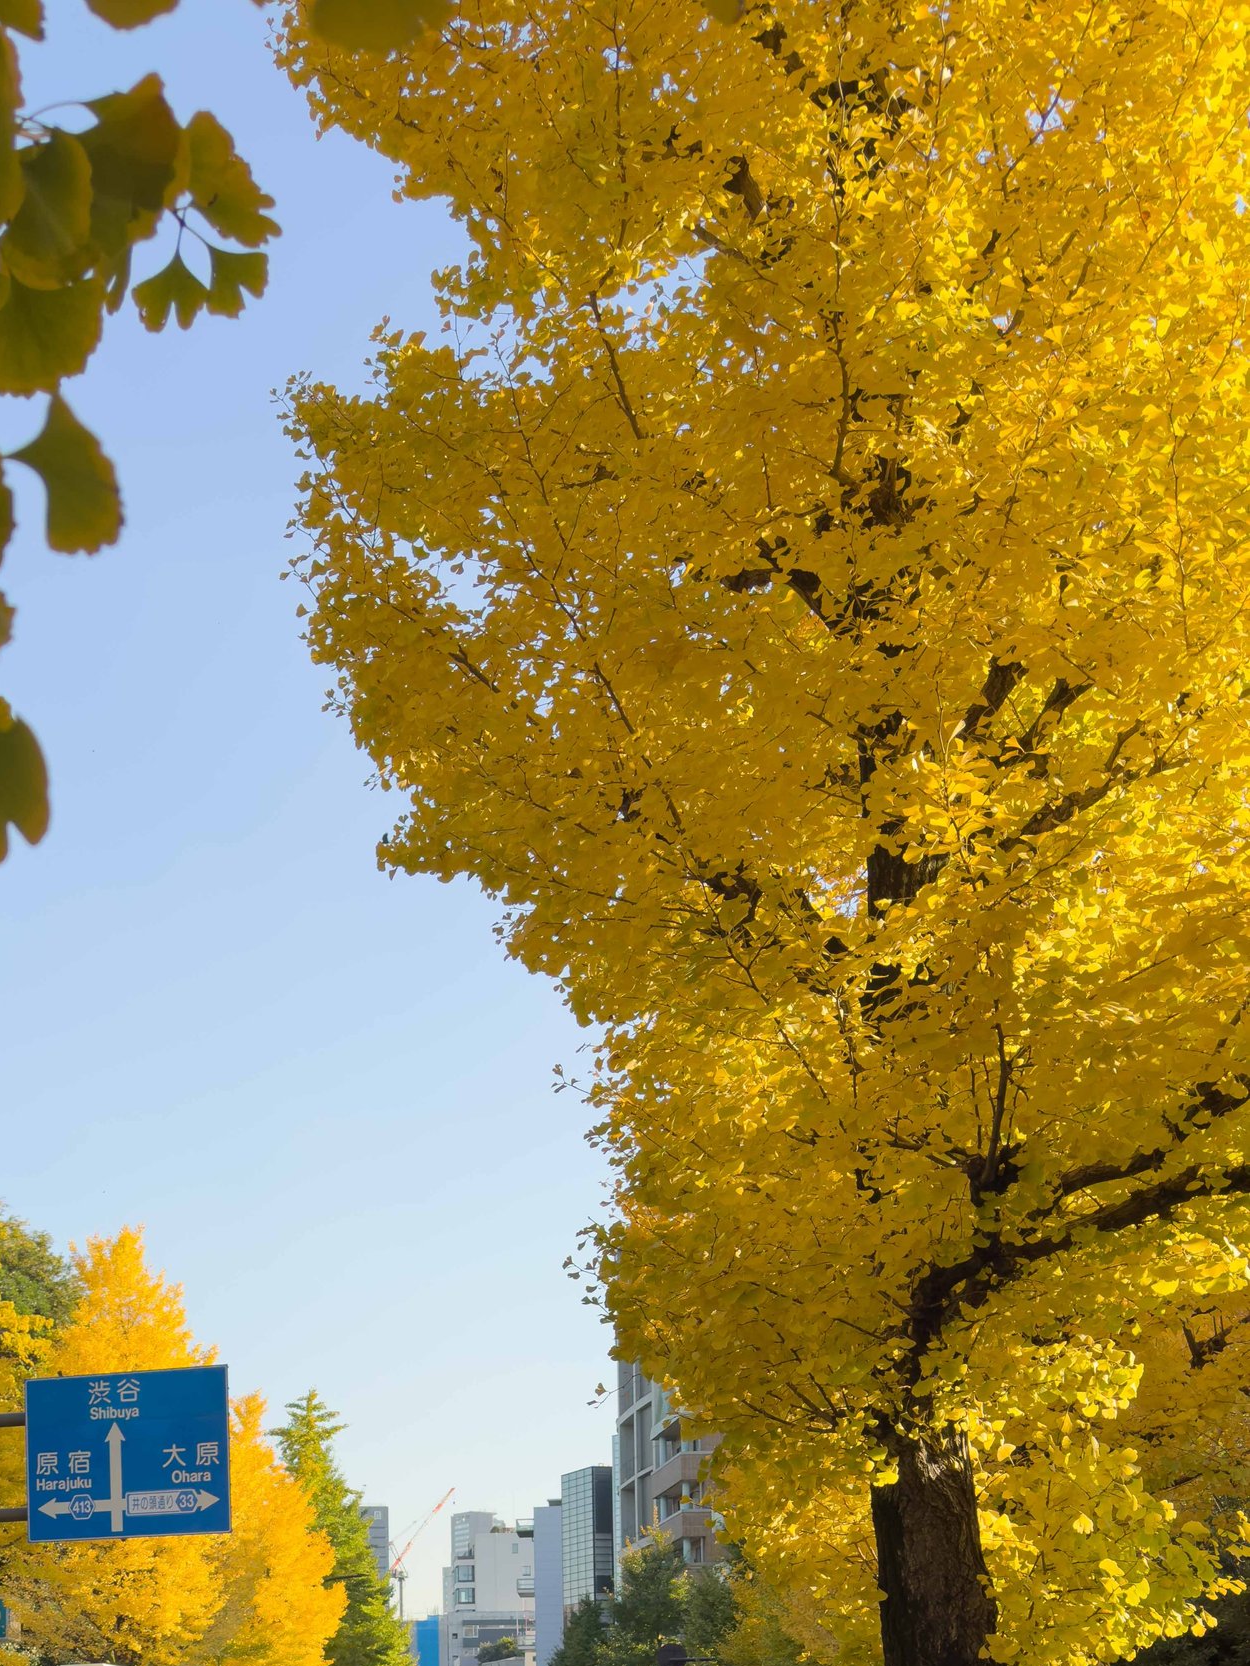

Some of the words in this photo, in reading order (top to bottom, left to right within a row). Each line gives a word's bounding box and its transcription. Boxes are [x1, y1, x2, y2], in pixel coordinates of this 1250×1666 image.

[88, 1379, 140, 1405] 渋谷
[89, 1407, 140, 1421] Shibuya
[36, 1450, 92, 1475] 原宿
[162, 1442, 220, 1468] 大原
[36, 1477, 92, 1492] Harajuku
[171, 1470, 211, 1484] Ohara
[71, 1501, 91, 1514] 413
[132, 1495, 174, 1510] 井の頭通り
[179, 1495, 194, 1508] 33
